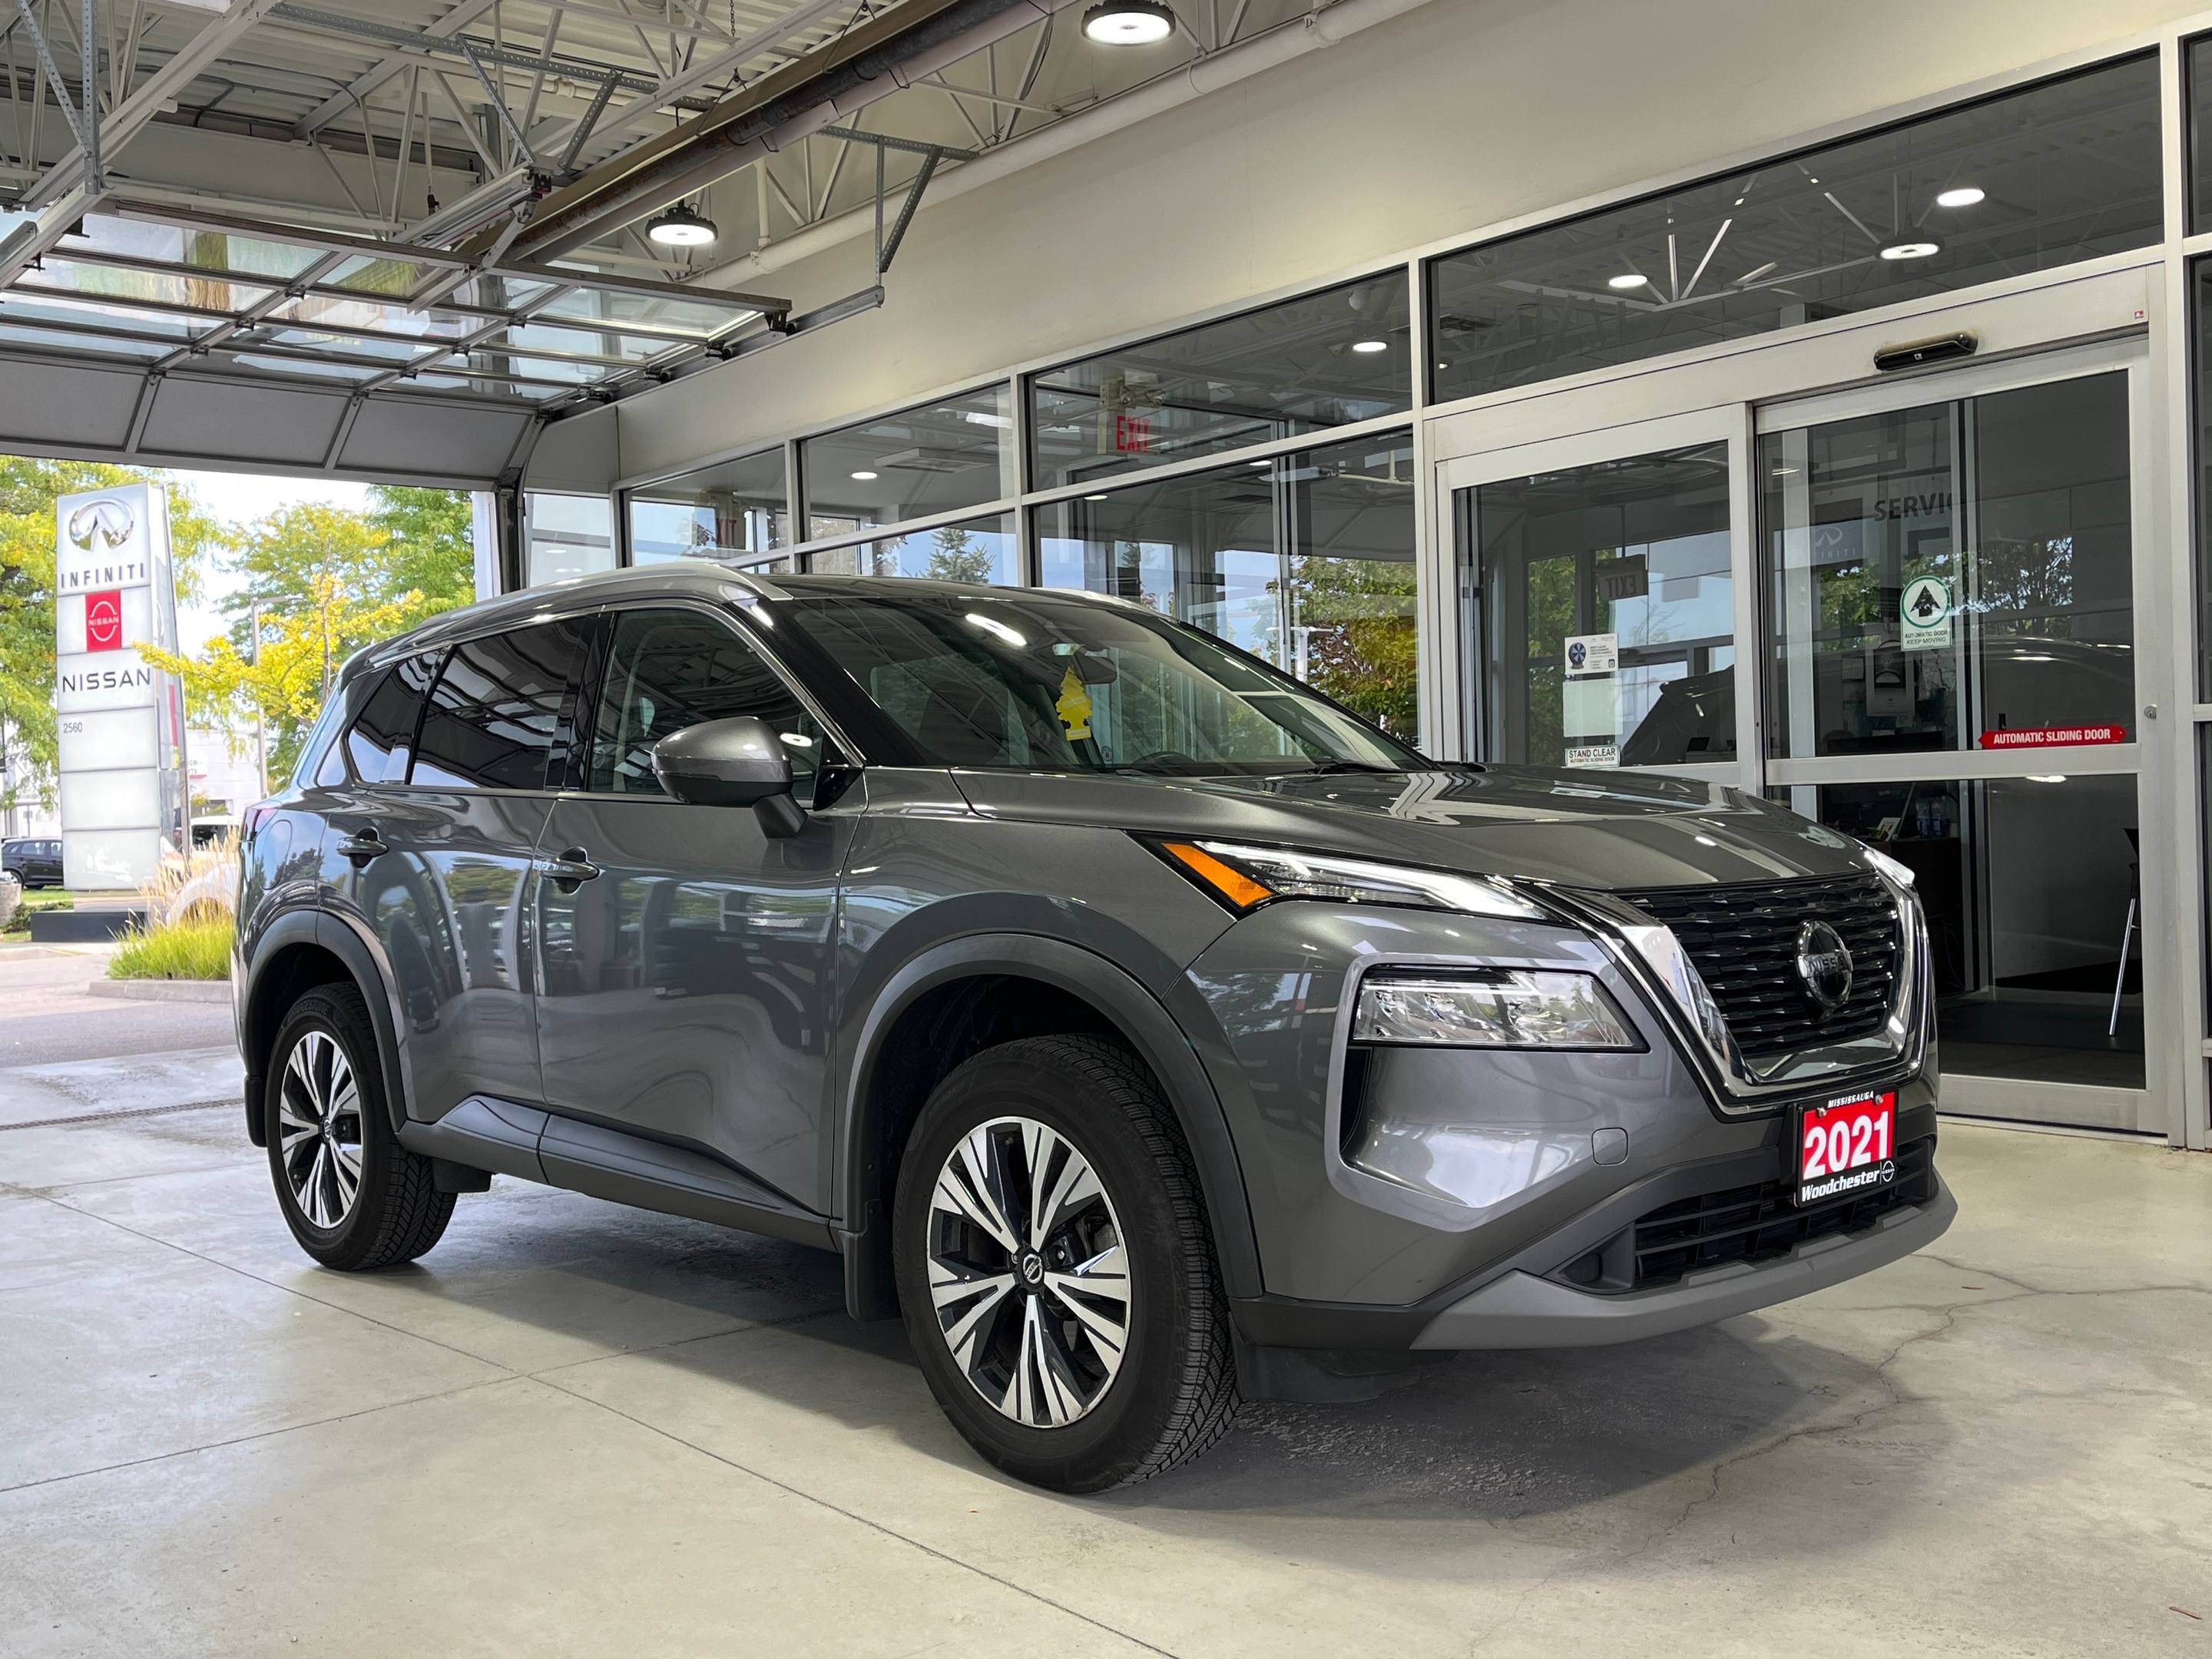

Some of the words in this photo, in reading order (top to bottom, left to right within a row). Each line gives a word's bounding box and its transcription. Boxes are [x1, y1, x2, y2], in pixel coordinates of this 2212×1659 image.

[1116, 416, 1151, 452] EXIT
[712, 518, 737, 546] XIT
[1821, 548, 1856, 559] INITI
[61, 563, 144, 588] INFINITI
[88, 616, 119, 627] NISSAN
[62, 667, 151, 692] NISSAN
[63, 722, 83, 733] 2560
[1993, 731, 2044, 744] AUTOMATIC
[2046, 730, 2082, 742] SLIDING
[2085, 728, 2111, 740] DOOR
[1569, 750, 1591, 759] STAND
[1593, 748, 1616, 757] CLEAR
[1827, 1091, 1874, 1108] MISSISSAUGA
[1803, 1111, 1889, 1181] 2021
[1802, 1169, 1880, 1202] Woodchester
